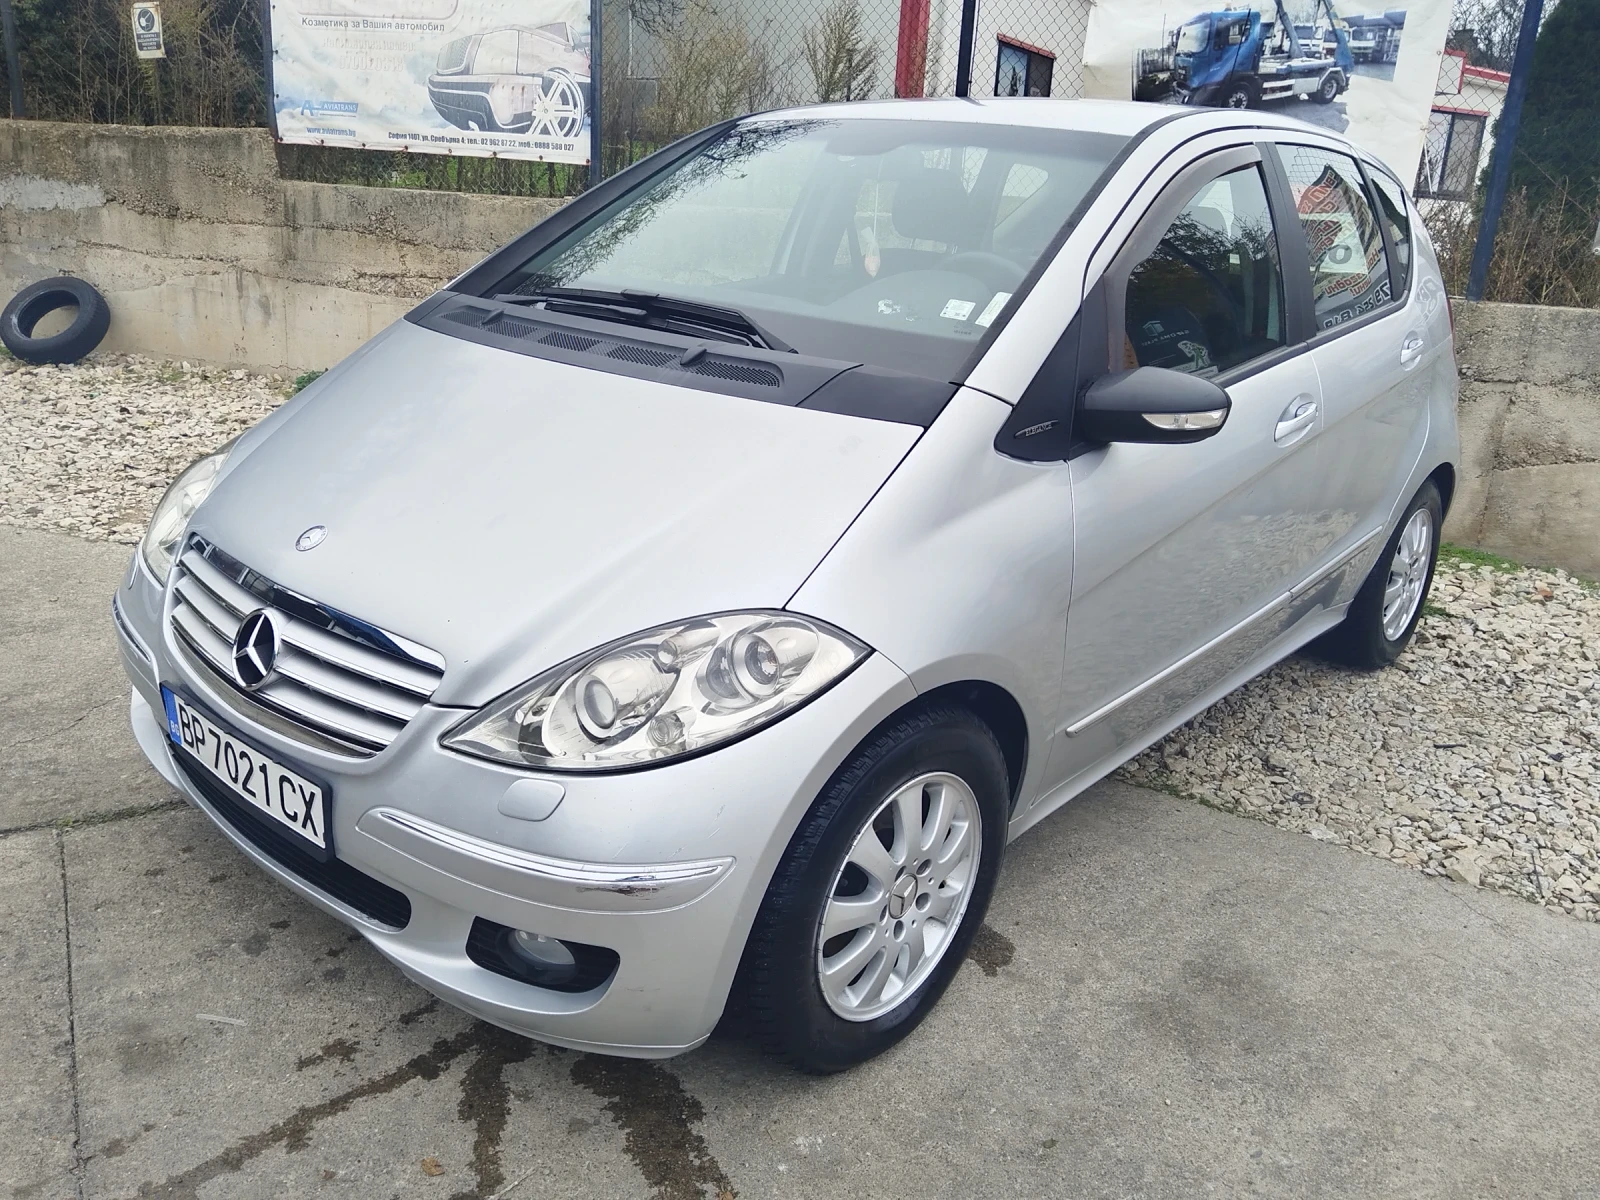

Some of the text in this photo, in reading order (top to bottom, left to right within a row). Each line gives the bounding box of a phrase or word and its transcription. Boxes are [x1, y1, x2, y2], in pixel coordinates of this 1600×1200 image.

[301, 17, 445, 32] Козметика за Вашия автомобил
[323, 102, 357, 112] AVIATRANS
[306, 127, 357, 138] www.aviatrans.bg
[388, 131, 407, 140] София
[431, 135, 460, 144] Сребърна
[489, 138, 500, 146] 962
[170, 719, 180, 736] BG
[208, 727, 271, 808] 7021
